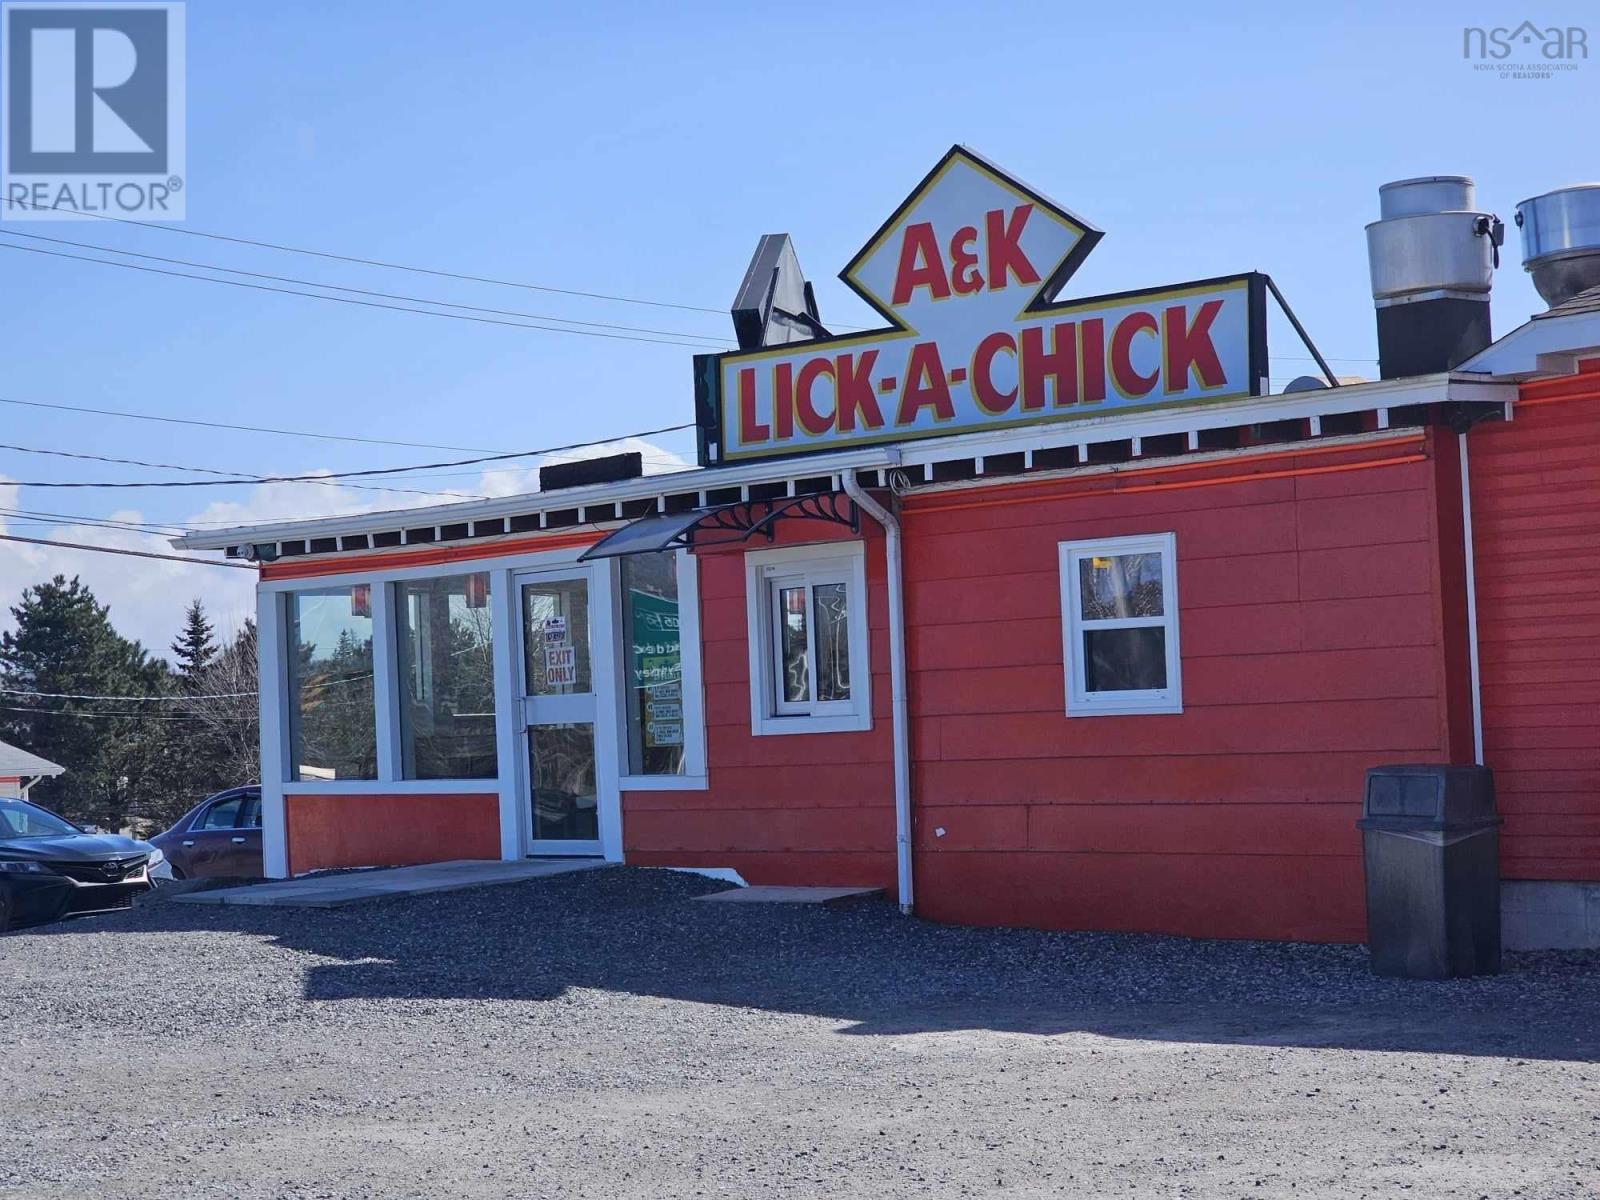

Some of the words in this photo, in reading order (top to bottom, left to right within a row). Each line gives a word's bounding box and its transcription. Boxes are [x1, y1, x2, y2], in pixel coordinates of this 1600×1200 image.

[892, 203, 1042, 307] A&K
[738, 299, 1228, 445] LICK-A-CHICK
[547, 666, 574, 682] ONLY
[549, 650, 571, 665] EXIT
